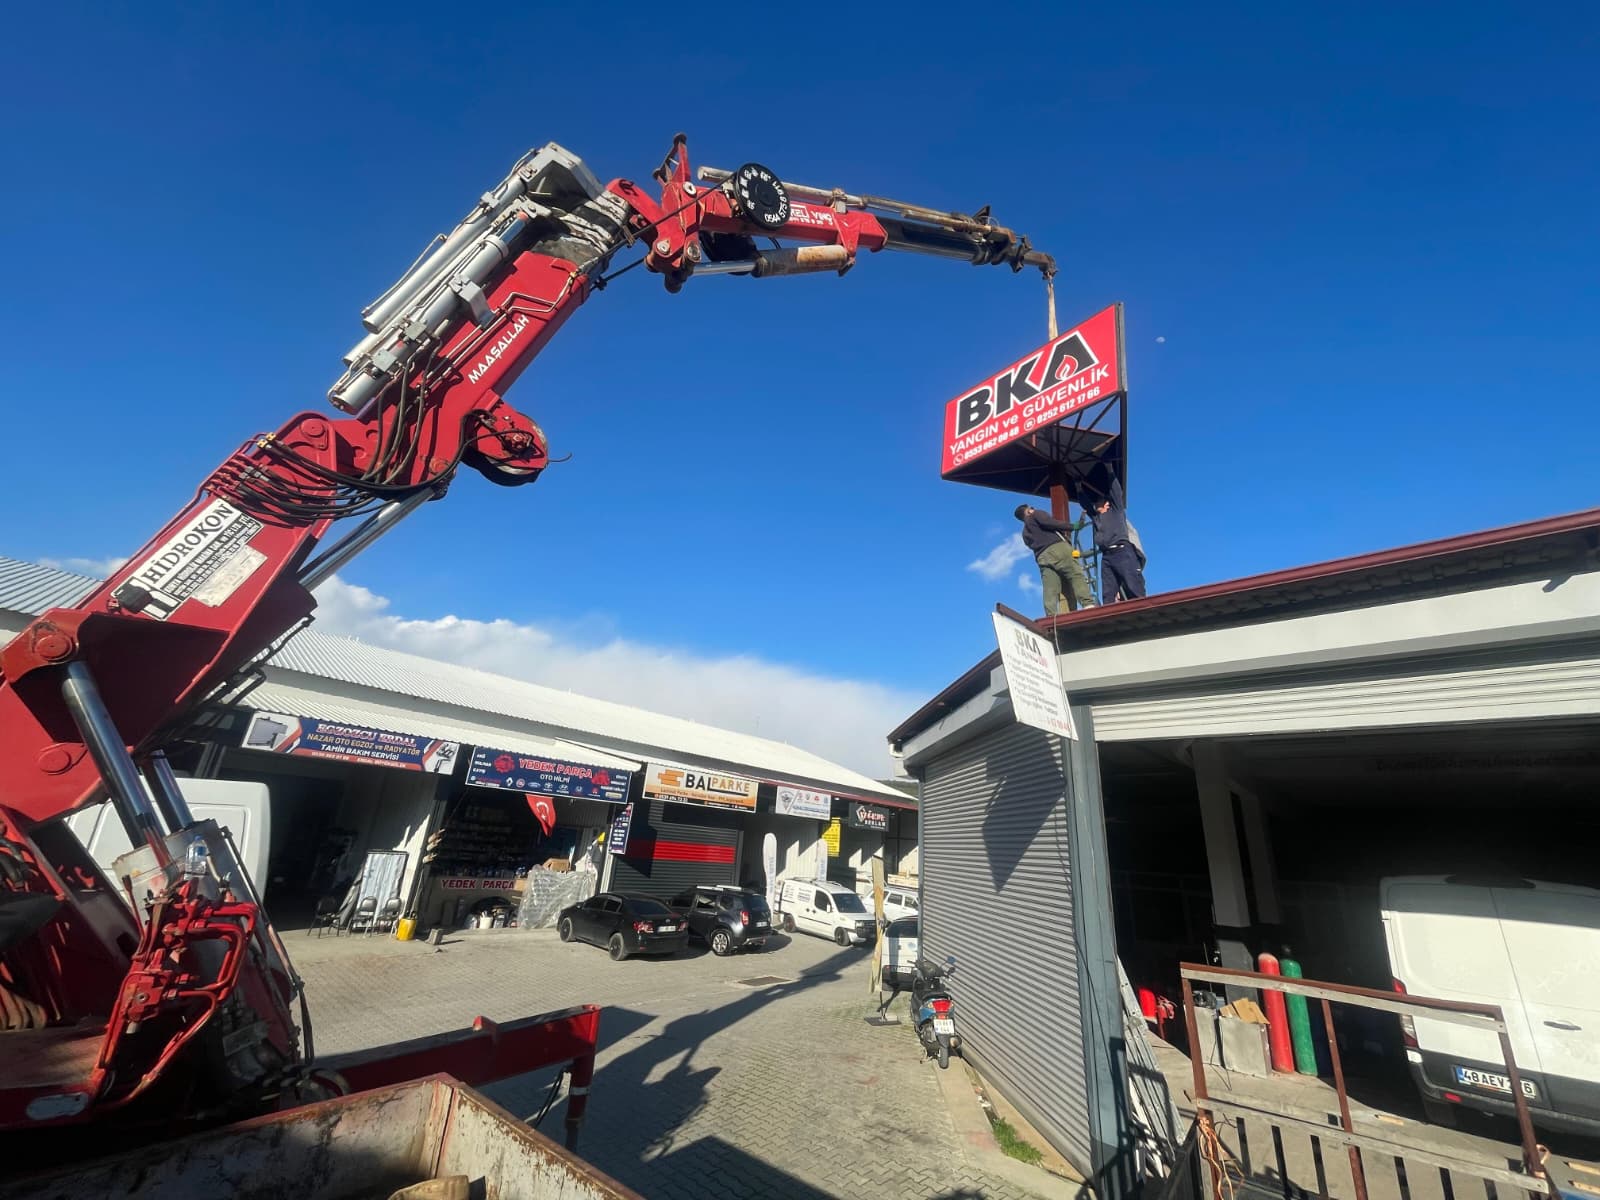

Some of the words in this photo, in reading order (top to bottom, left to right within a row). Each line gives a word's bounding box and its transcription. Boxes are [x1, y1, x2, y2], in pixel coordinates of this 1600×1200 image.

[467, 314, 530, 385] MAAŞALLAH
[955, 330, 1099, 439] BKA
[950, 421, 999, 455] YANGIN
[1002, 415, 1018, 428] ve
[1023, 363, 1109, 417] GÜVENLİK
[142, 503, 235, 584] HİDROKON
[307, 733, 335, 743] NAZAR
[384, 744, 421, 756] RADYATÖR
[320, 744, 346, 754] TAMİR
[346, 748, 371, 757] BAKIM
[371, 751, 400, 761] SERVİSİ
[519, 758, 556, 773] YEDEK
[557, 764, 593, 779] PARÇA
[442, 880, 475, 888] YEDEK
[483, 881, 514, 890] PARÇA
[1464, 1071, 1479, 1083] 48
[1482, 1074, 1504, 1088] AEV
